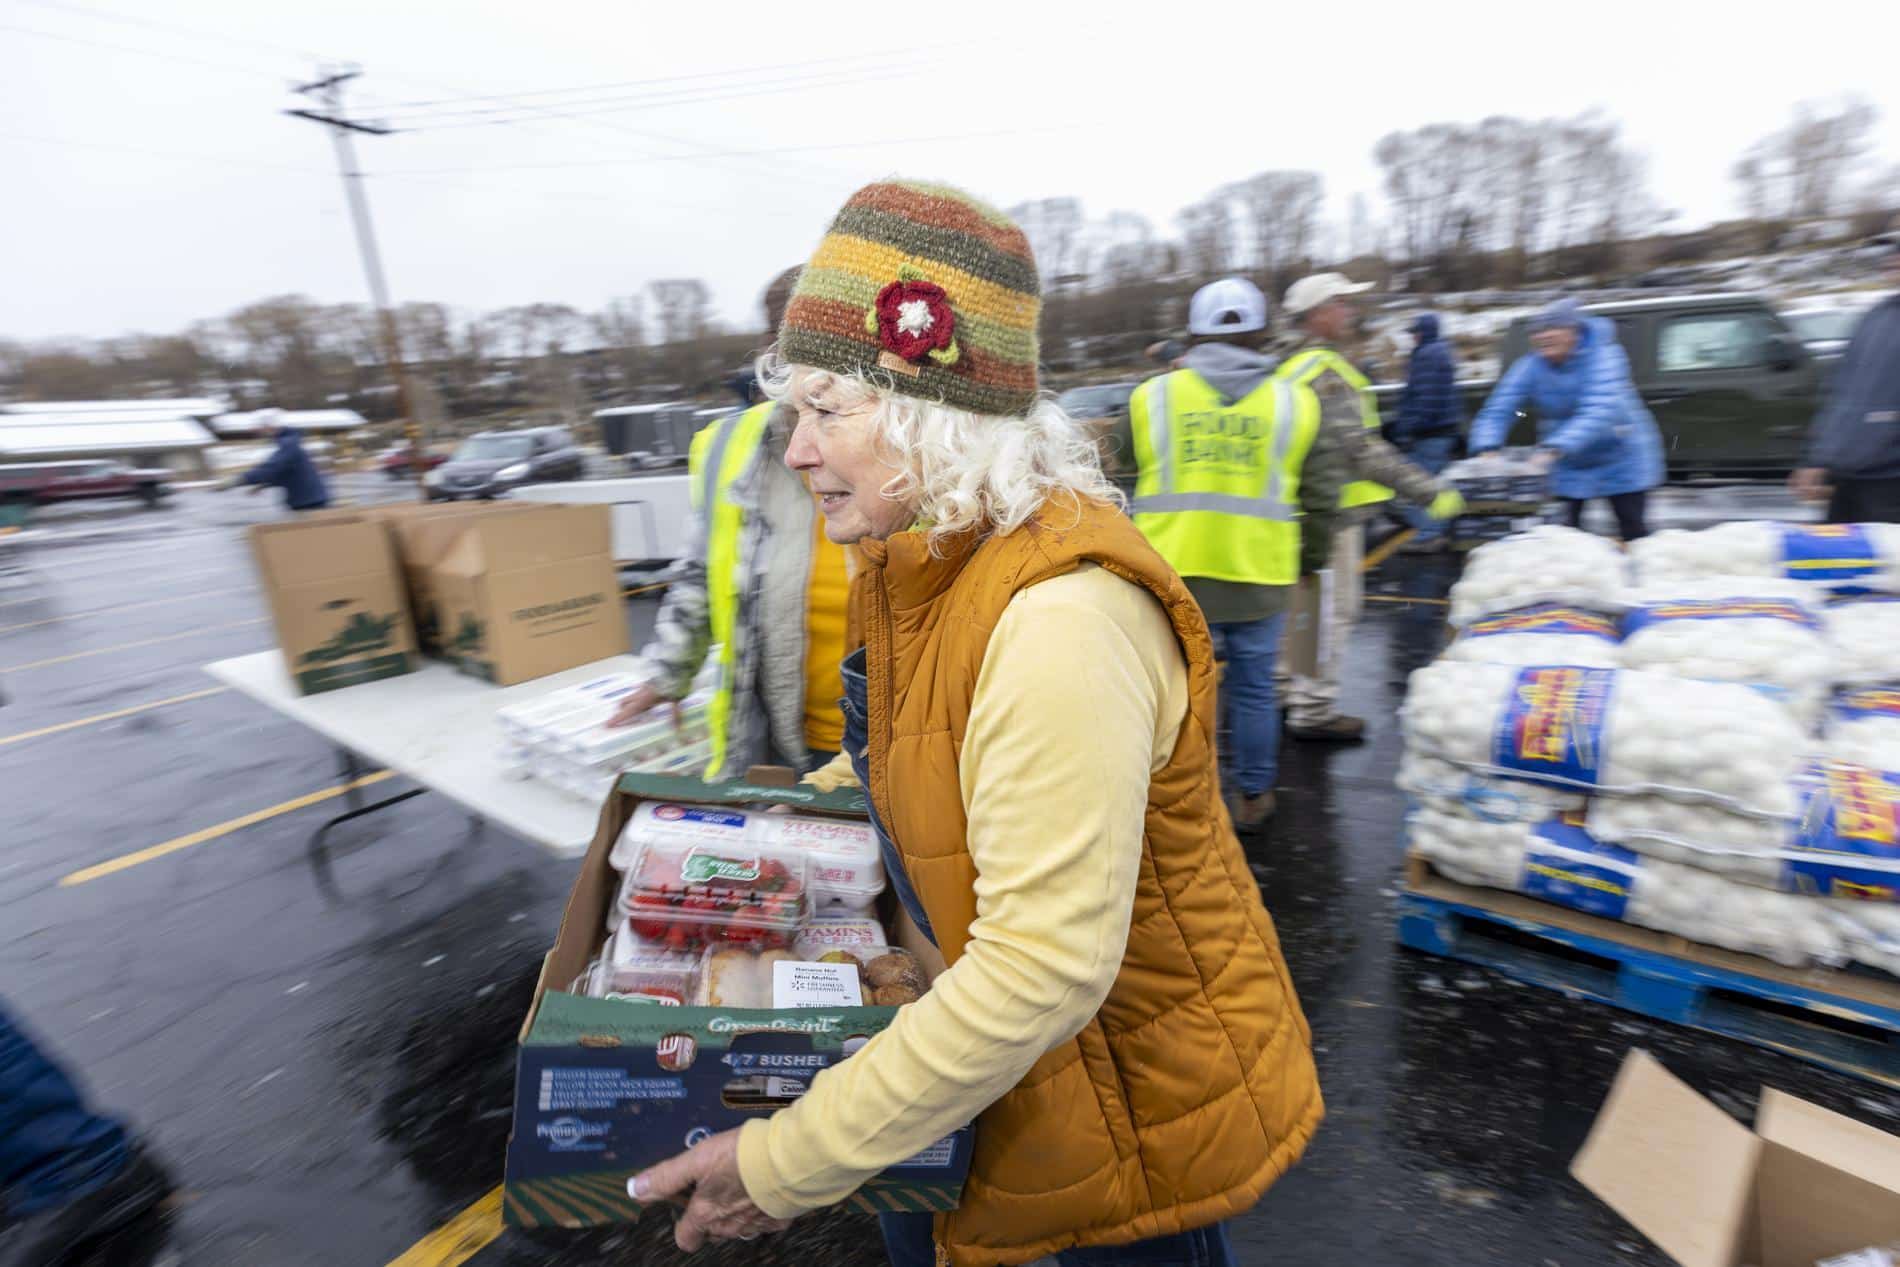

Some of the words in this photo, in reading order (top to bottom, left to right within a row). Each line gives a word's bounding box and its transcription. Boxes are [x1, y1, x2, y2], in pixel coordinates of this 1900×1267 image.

[1180, 411, 1264, 440] FOOD
[1180, 438, 1262, 467] BANK
[720, 1053, 754, 1067] 4/7
[759, 1054, 826, 1067] BUSHEL
